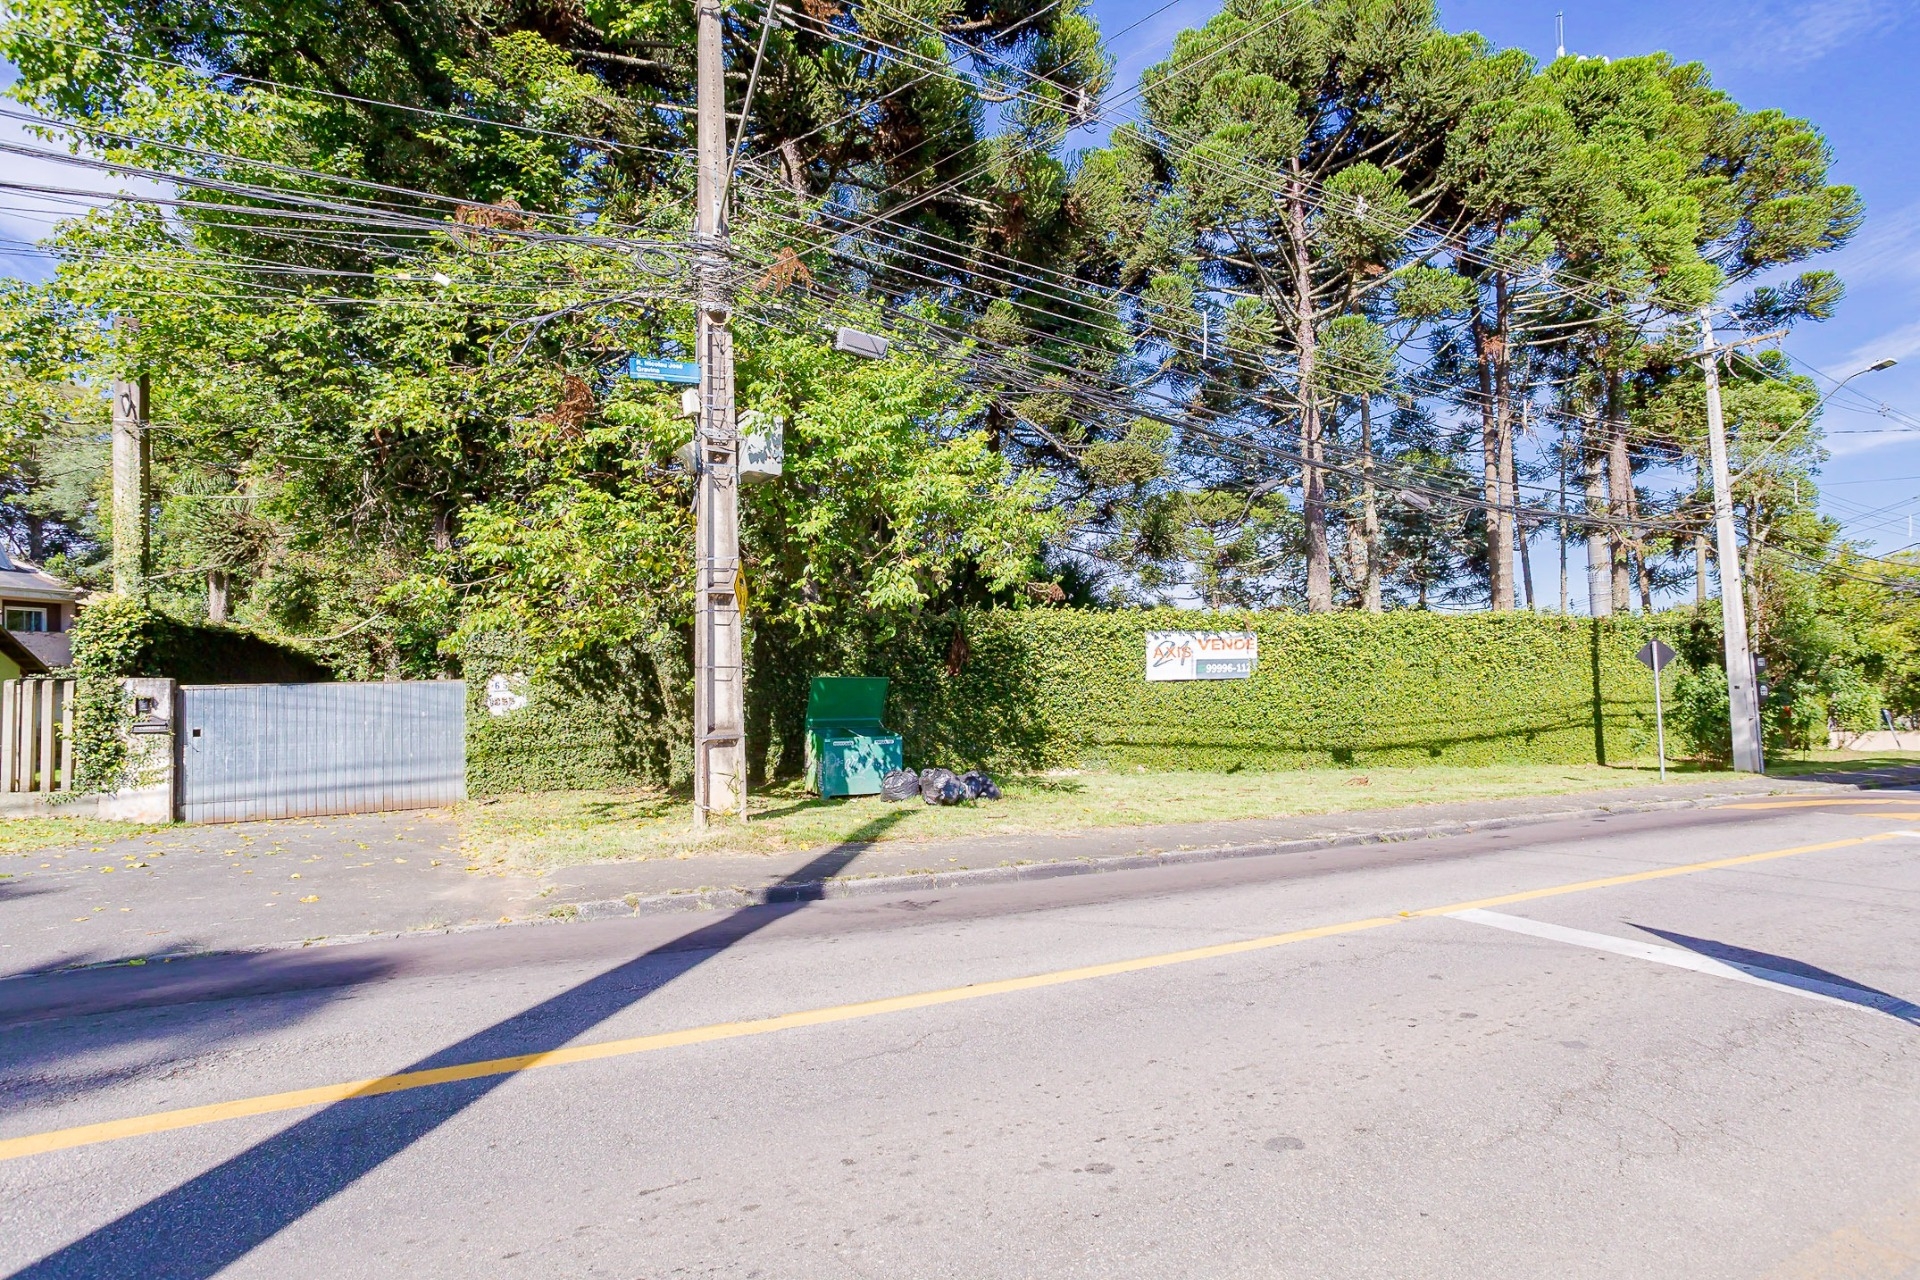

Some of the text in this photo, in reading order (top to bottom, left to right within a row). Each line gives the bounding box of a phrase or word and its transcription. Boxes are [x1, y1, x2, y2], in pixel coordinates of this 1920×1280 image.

[636, 359, 643, 367] R.
[644, 360, 667, 368] Nicolau
[1197, 638, 1255, 650] VENDE
[1153, 647, 1192, 659] AXIS
